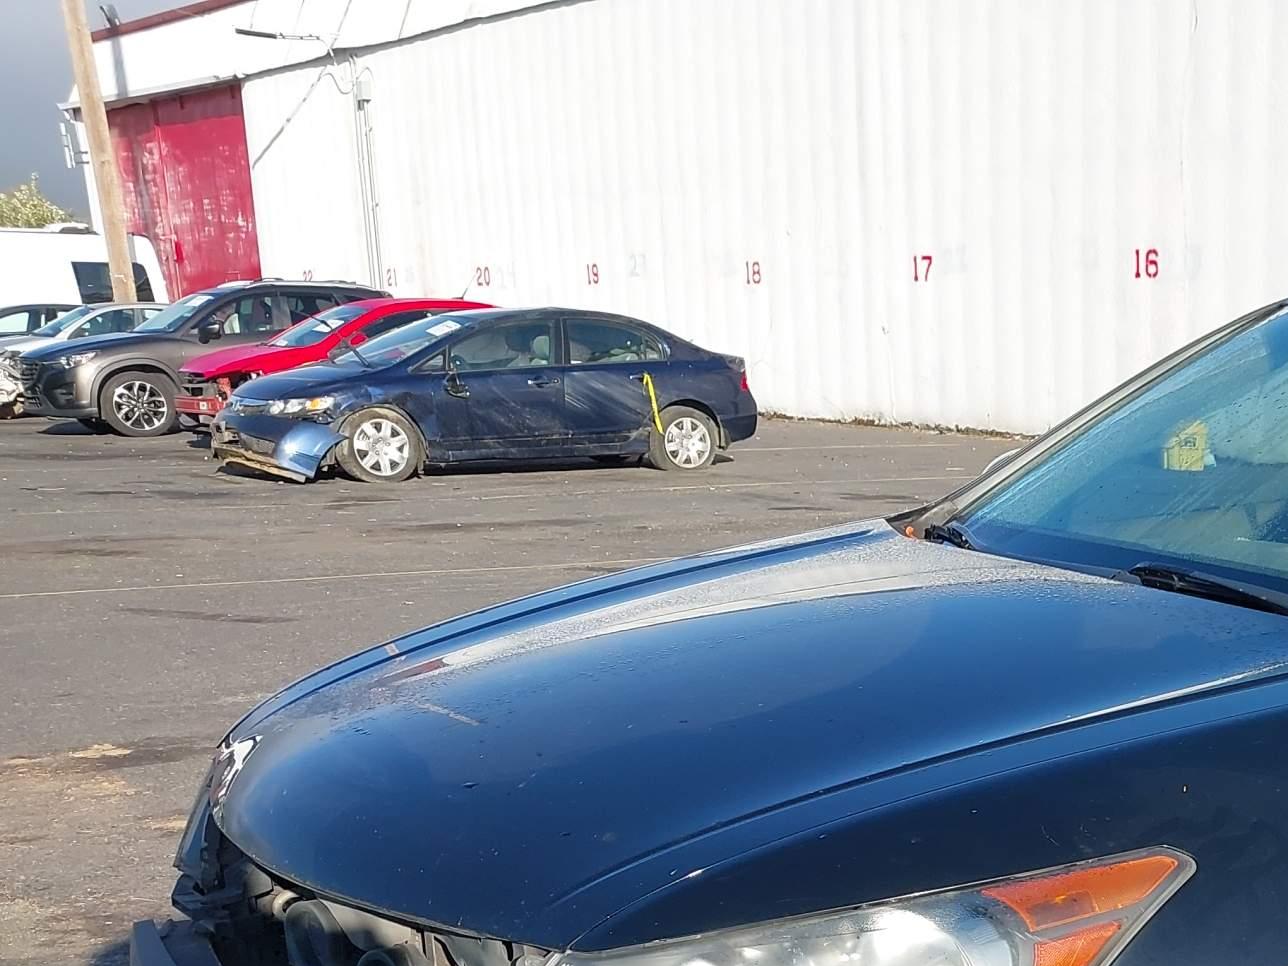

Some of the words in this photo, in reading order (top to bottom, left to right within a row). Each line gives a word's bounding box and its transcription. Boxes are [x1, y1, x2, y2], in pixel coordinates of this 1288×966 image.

[586, 263, 600, 285] 19
[745, 261, 761, 285] 18
[913, 255, 933, 282] 17
[1134, 248, 1160, 279] 16
[386, 267, 398, 288] 21
[476, 266, 491, 287] 20
